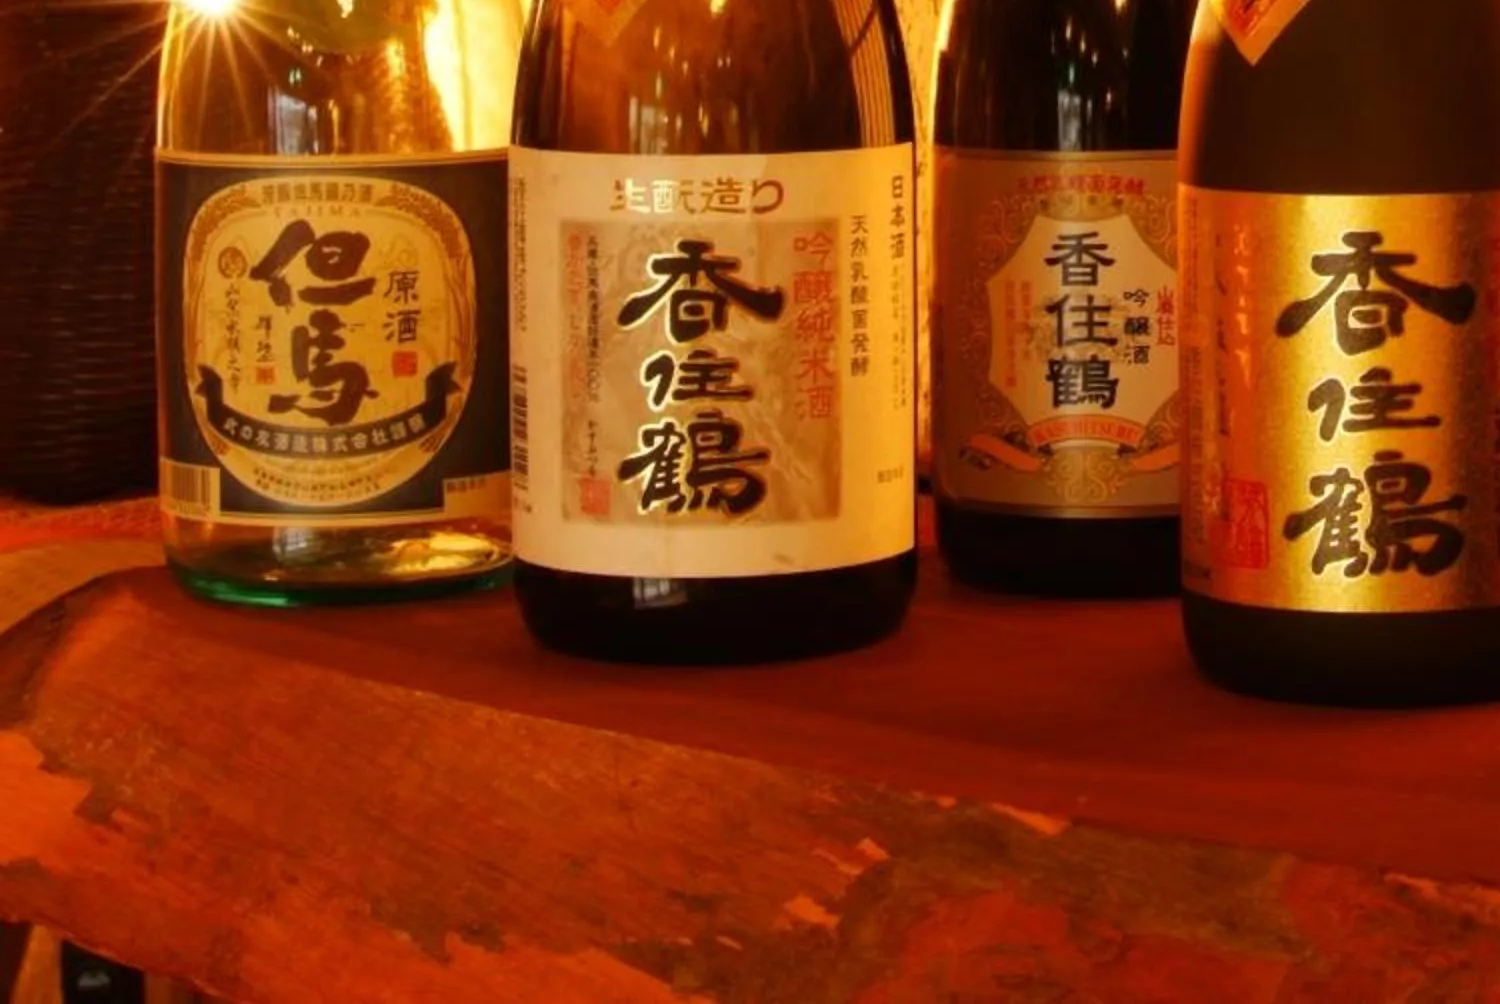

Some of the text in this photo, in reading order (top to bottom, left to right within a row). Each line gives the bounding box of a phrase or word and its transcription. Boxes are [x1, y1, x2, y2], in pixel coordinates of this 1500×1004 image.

[383, 269, 422, 344] 原酒
[849, 214, 870, 378] 天然乳酸菌発酵
[889, 175, 905, 260] 日本酒
[250, 218, 381, 426] 但馬
[616, 238, 786, 514] 香住鶴
[793, 235, 835, 420] 吟醸純米酒
[1043, 231, 1120, 410] 香住鶴
[1123, 287, 1151, 366] 吟醸酒
[1275, 230, 1476, 578] 香住鶴
